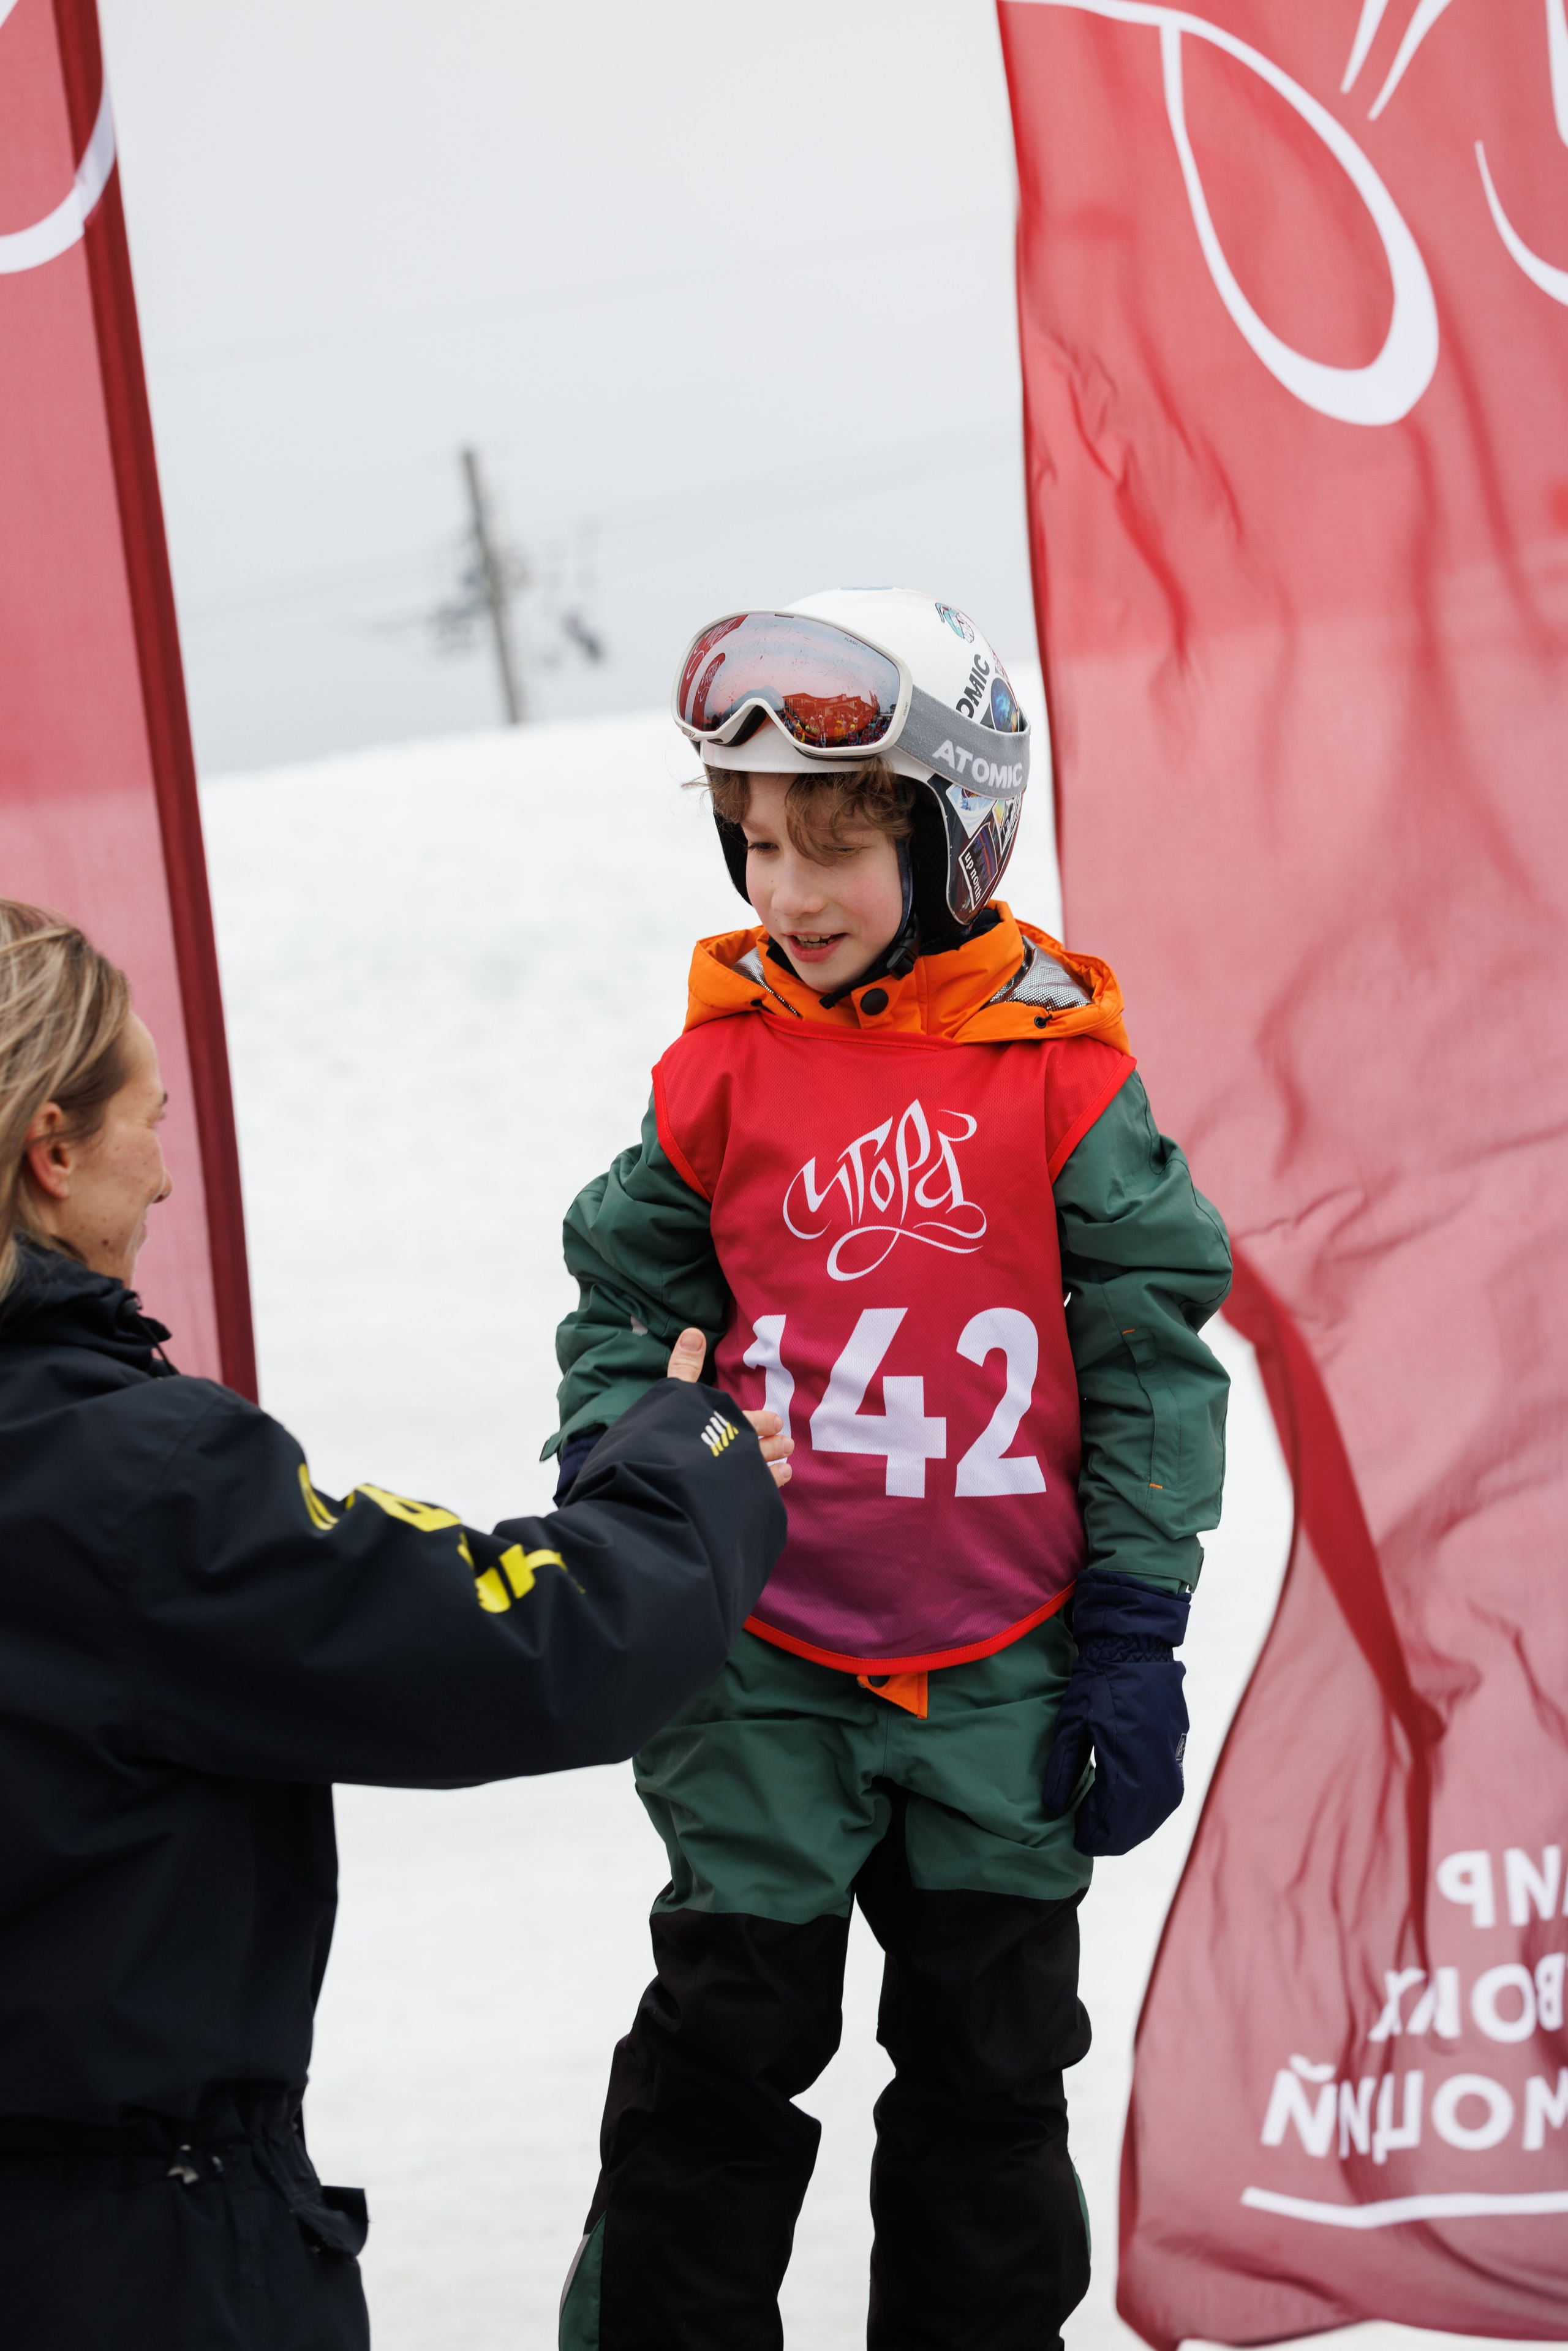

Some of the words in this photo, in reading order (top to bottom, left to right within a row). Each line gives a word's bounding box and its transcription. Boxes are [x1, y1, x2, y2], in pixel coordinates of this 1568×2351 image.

[844, 637, 858, 646] FLASH
[932, 739, 1023, 788] ATOMIC
[965, 851, 974, 870] up
[970, 869, 982, 901] north
[743, 1307, 1047, 1498] 142
